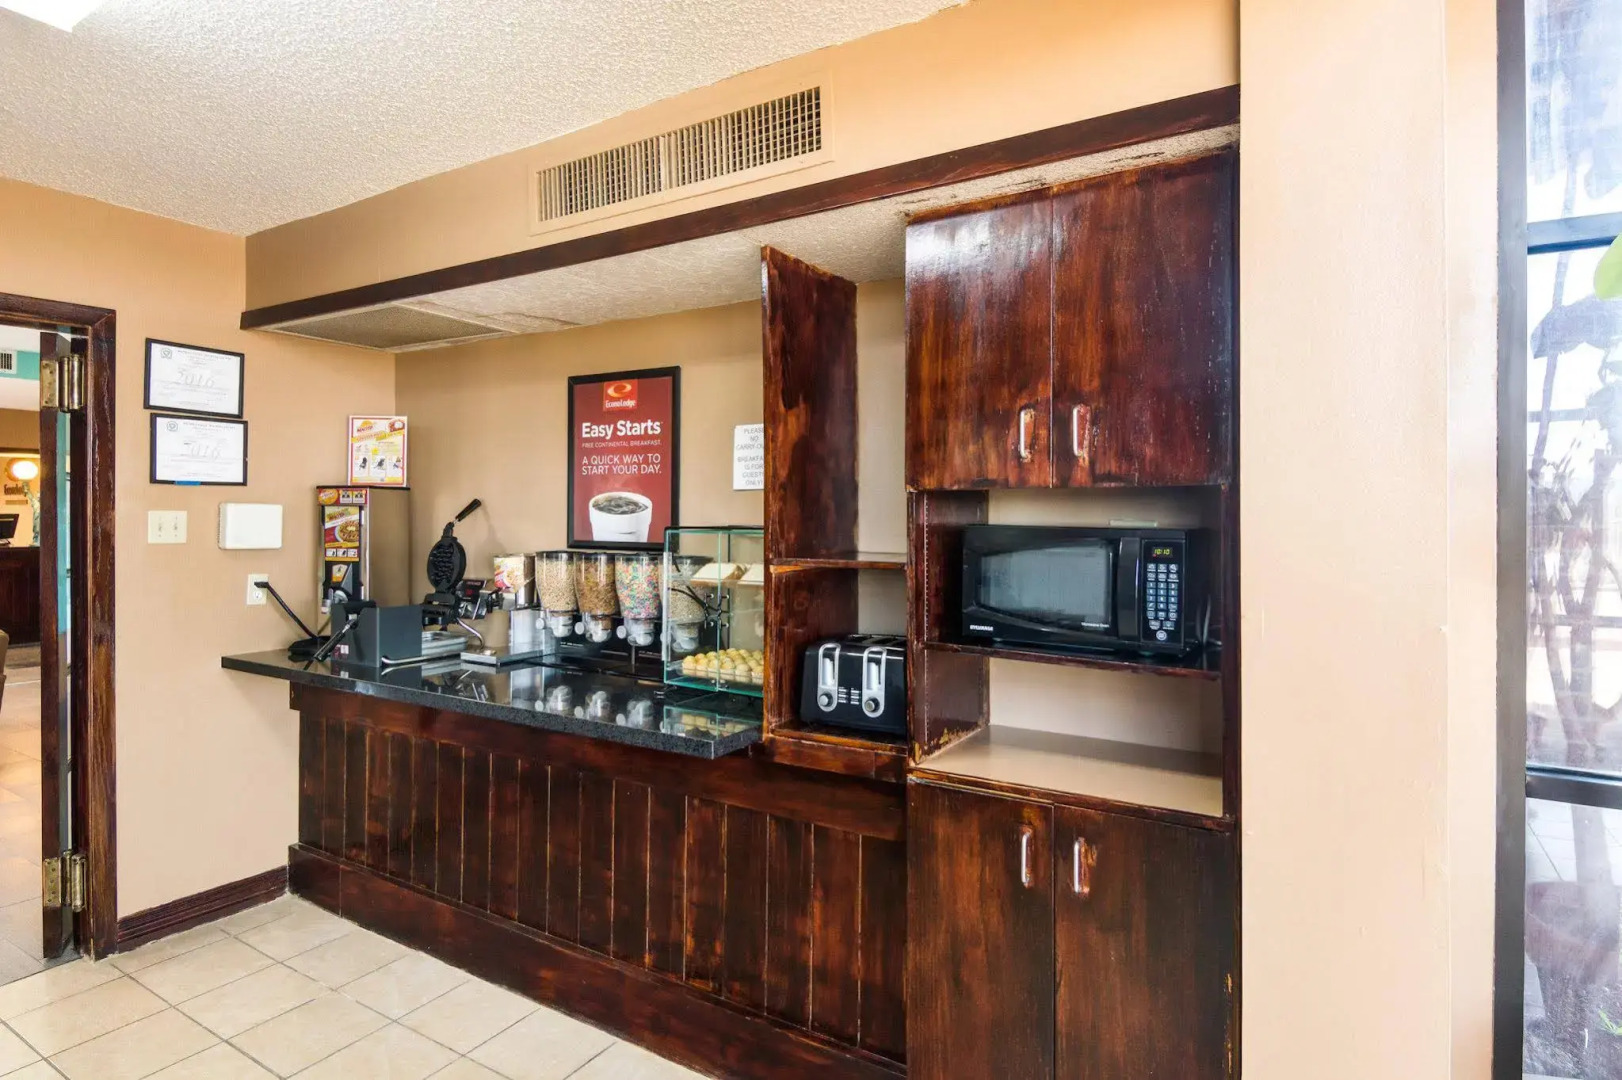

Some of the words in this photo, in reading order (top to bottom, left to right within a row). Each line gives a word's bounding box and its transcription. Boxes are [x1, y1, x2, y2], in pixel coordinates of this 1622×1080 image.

[582, 422, 614, 440] Easy
[616, 419, 661, 436] Starts
[582, 456, 589, 465] A
[590, 454, 620, 465] QUICK
[622, 453, 644, 464] WAY
[647, 453, 661, 463] TO
[582, 465, 610, 475] START
[612, 465, 638, 475] YOUR
[640, 464, 662, 475] DAY.
